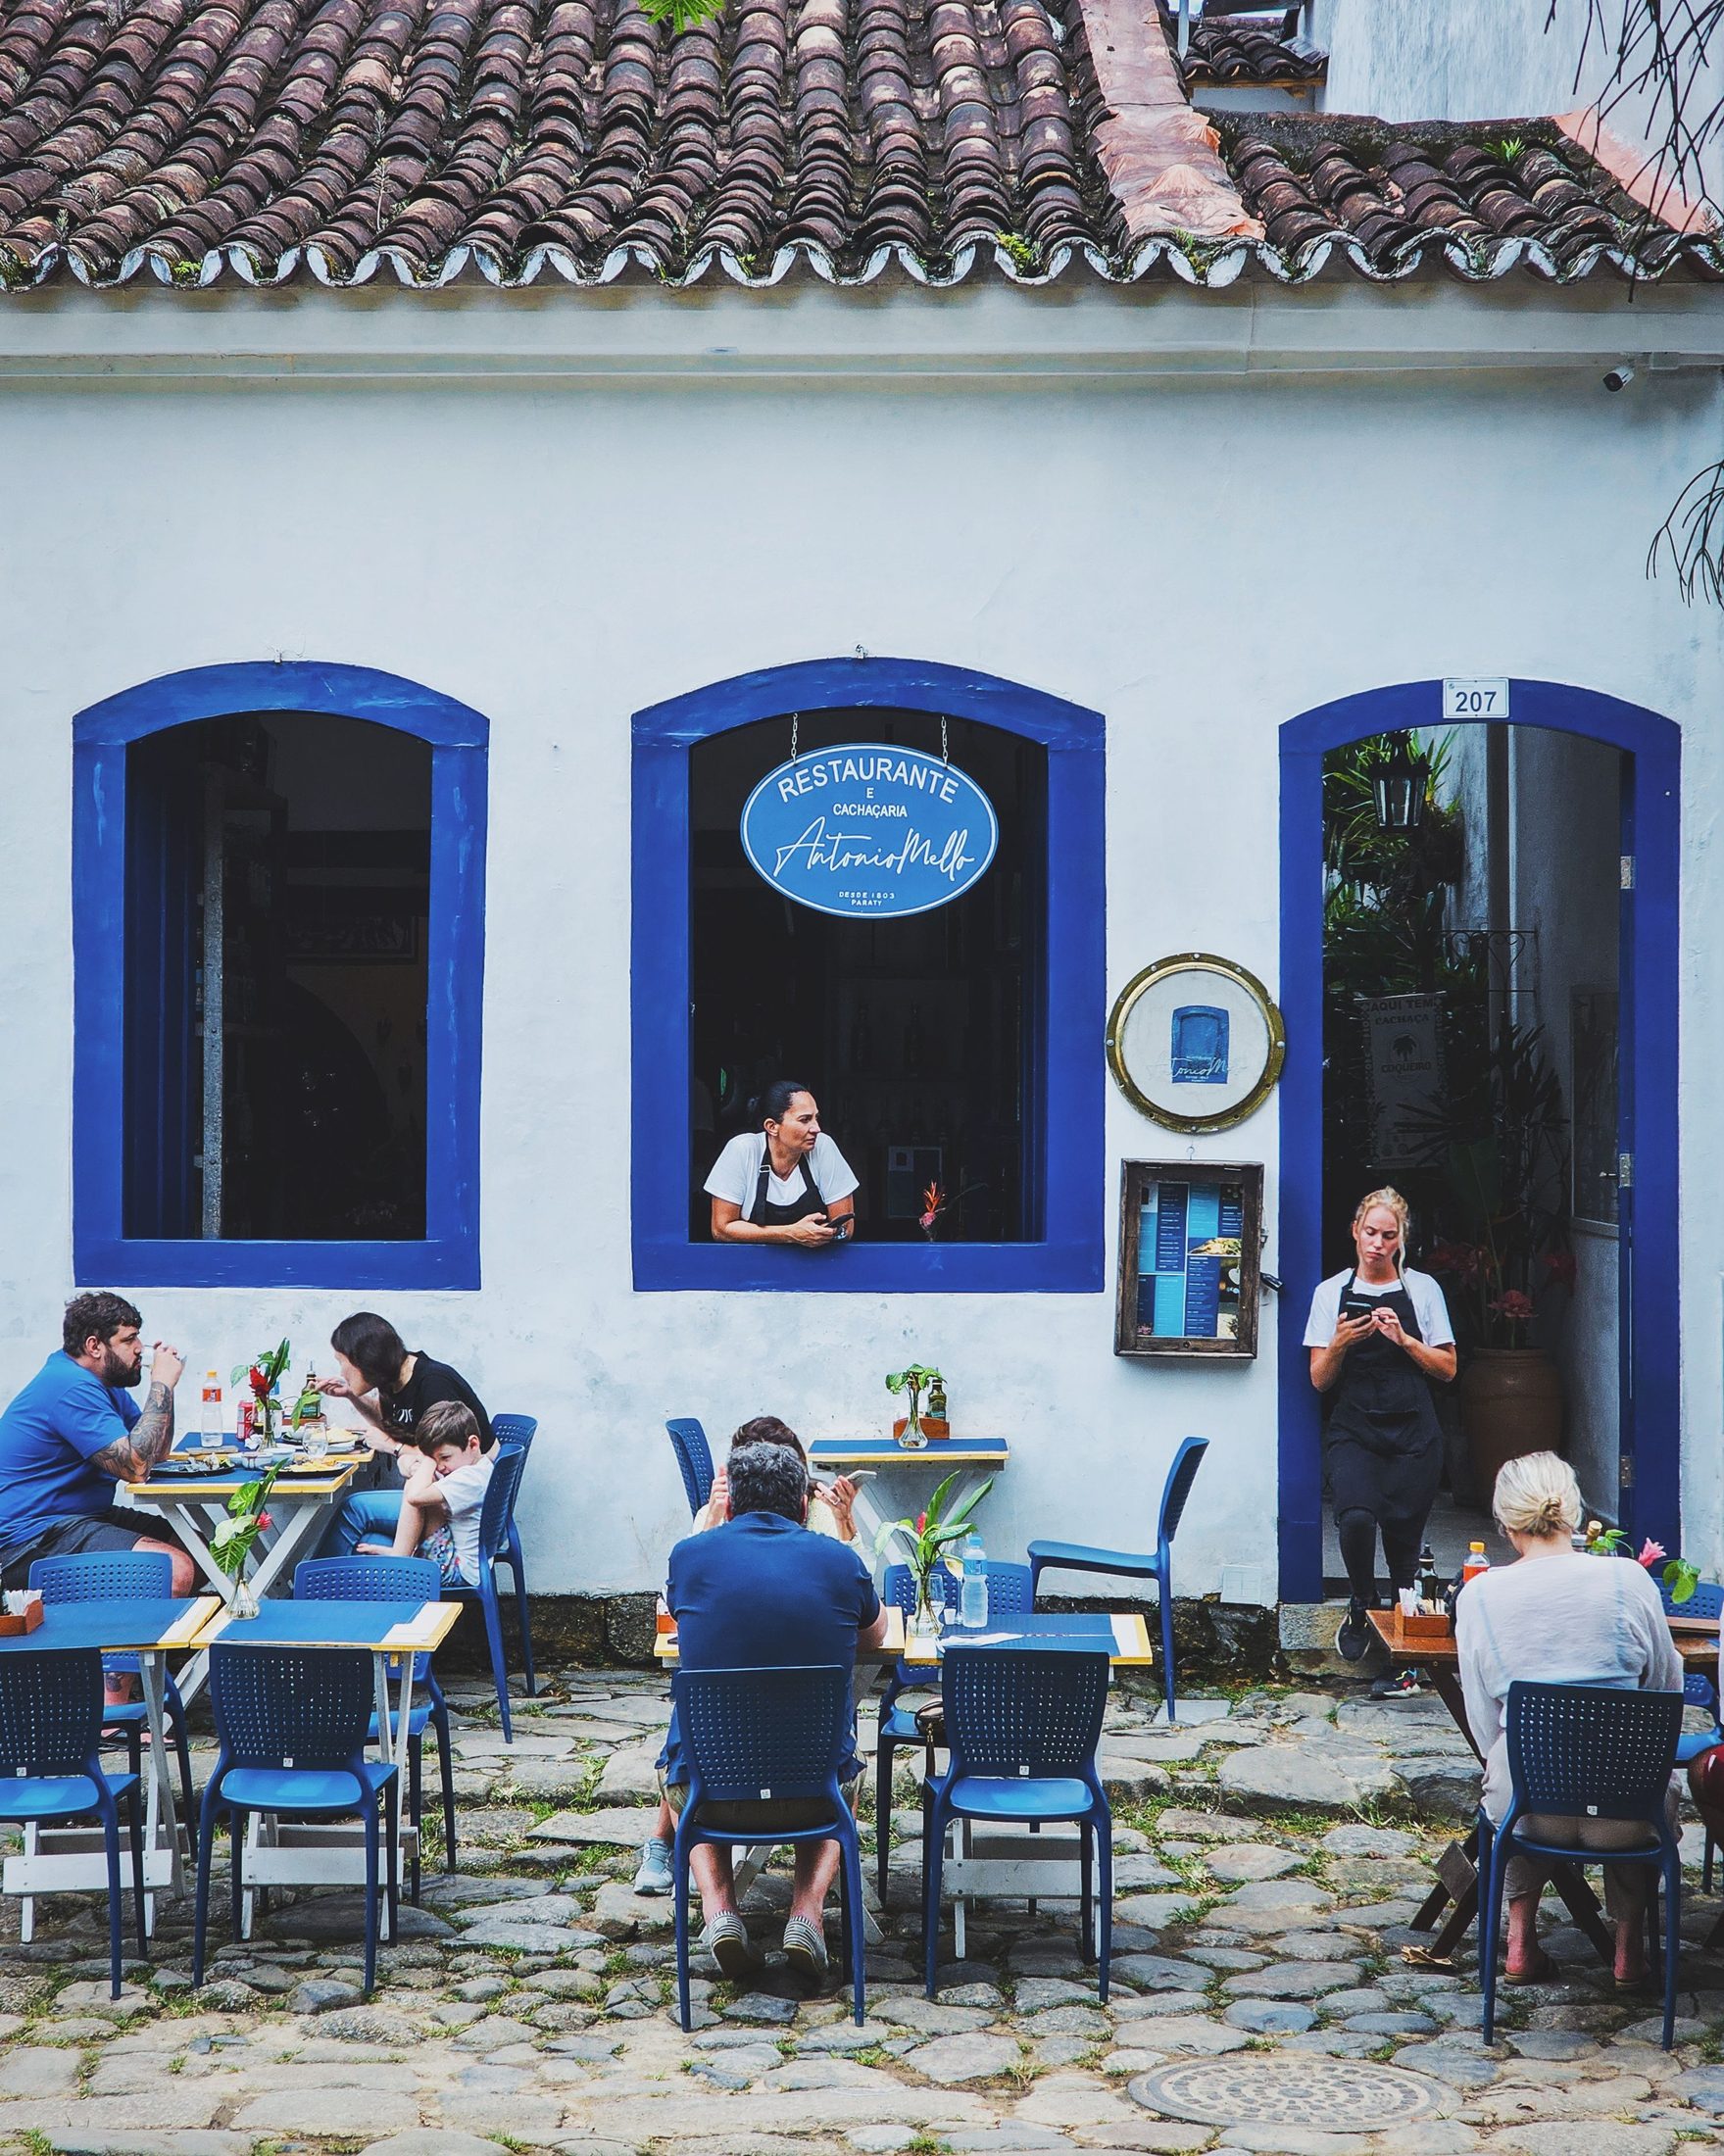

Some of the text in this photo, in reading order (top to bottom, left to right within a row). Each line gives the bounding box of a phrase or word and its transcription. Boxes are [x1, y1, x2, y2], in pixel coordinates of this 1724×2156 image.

[1455, 691, 1498, 712] 207
[777, 758, 960, 804] RESTAURANTE
[865, 787, 874, 799] E
[833, 804, 908, 819] CACHAÇARIA
[1372, 999, 1433, 1012] AQUI TEM
[1375, 1013, 1429, 1025] CACHAÇA
[1381, 1061, 1432, 1074] COQUEIRO
